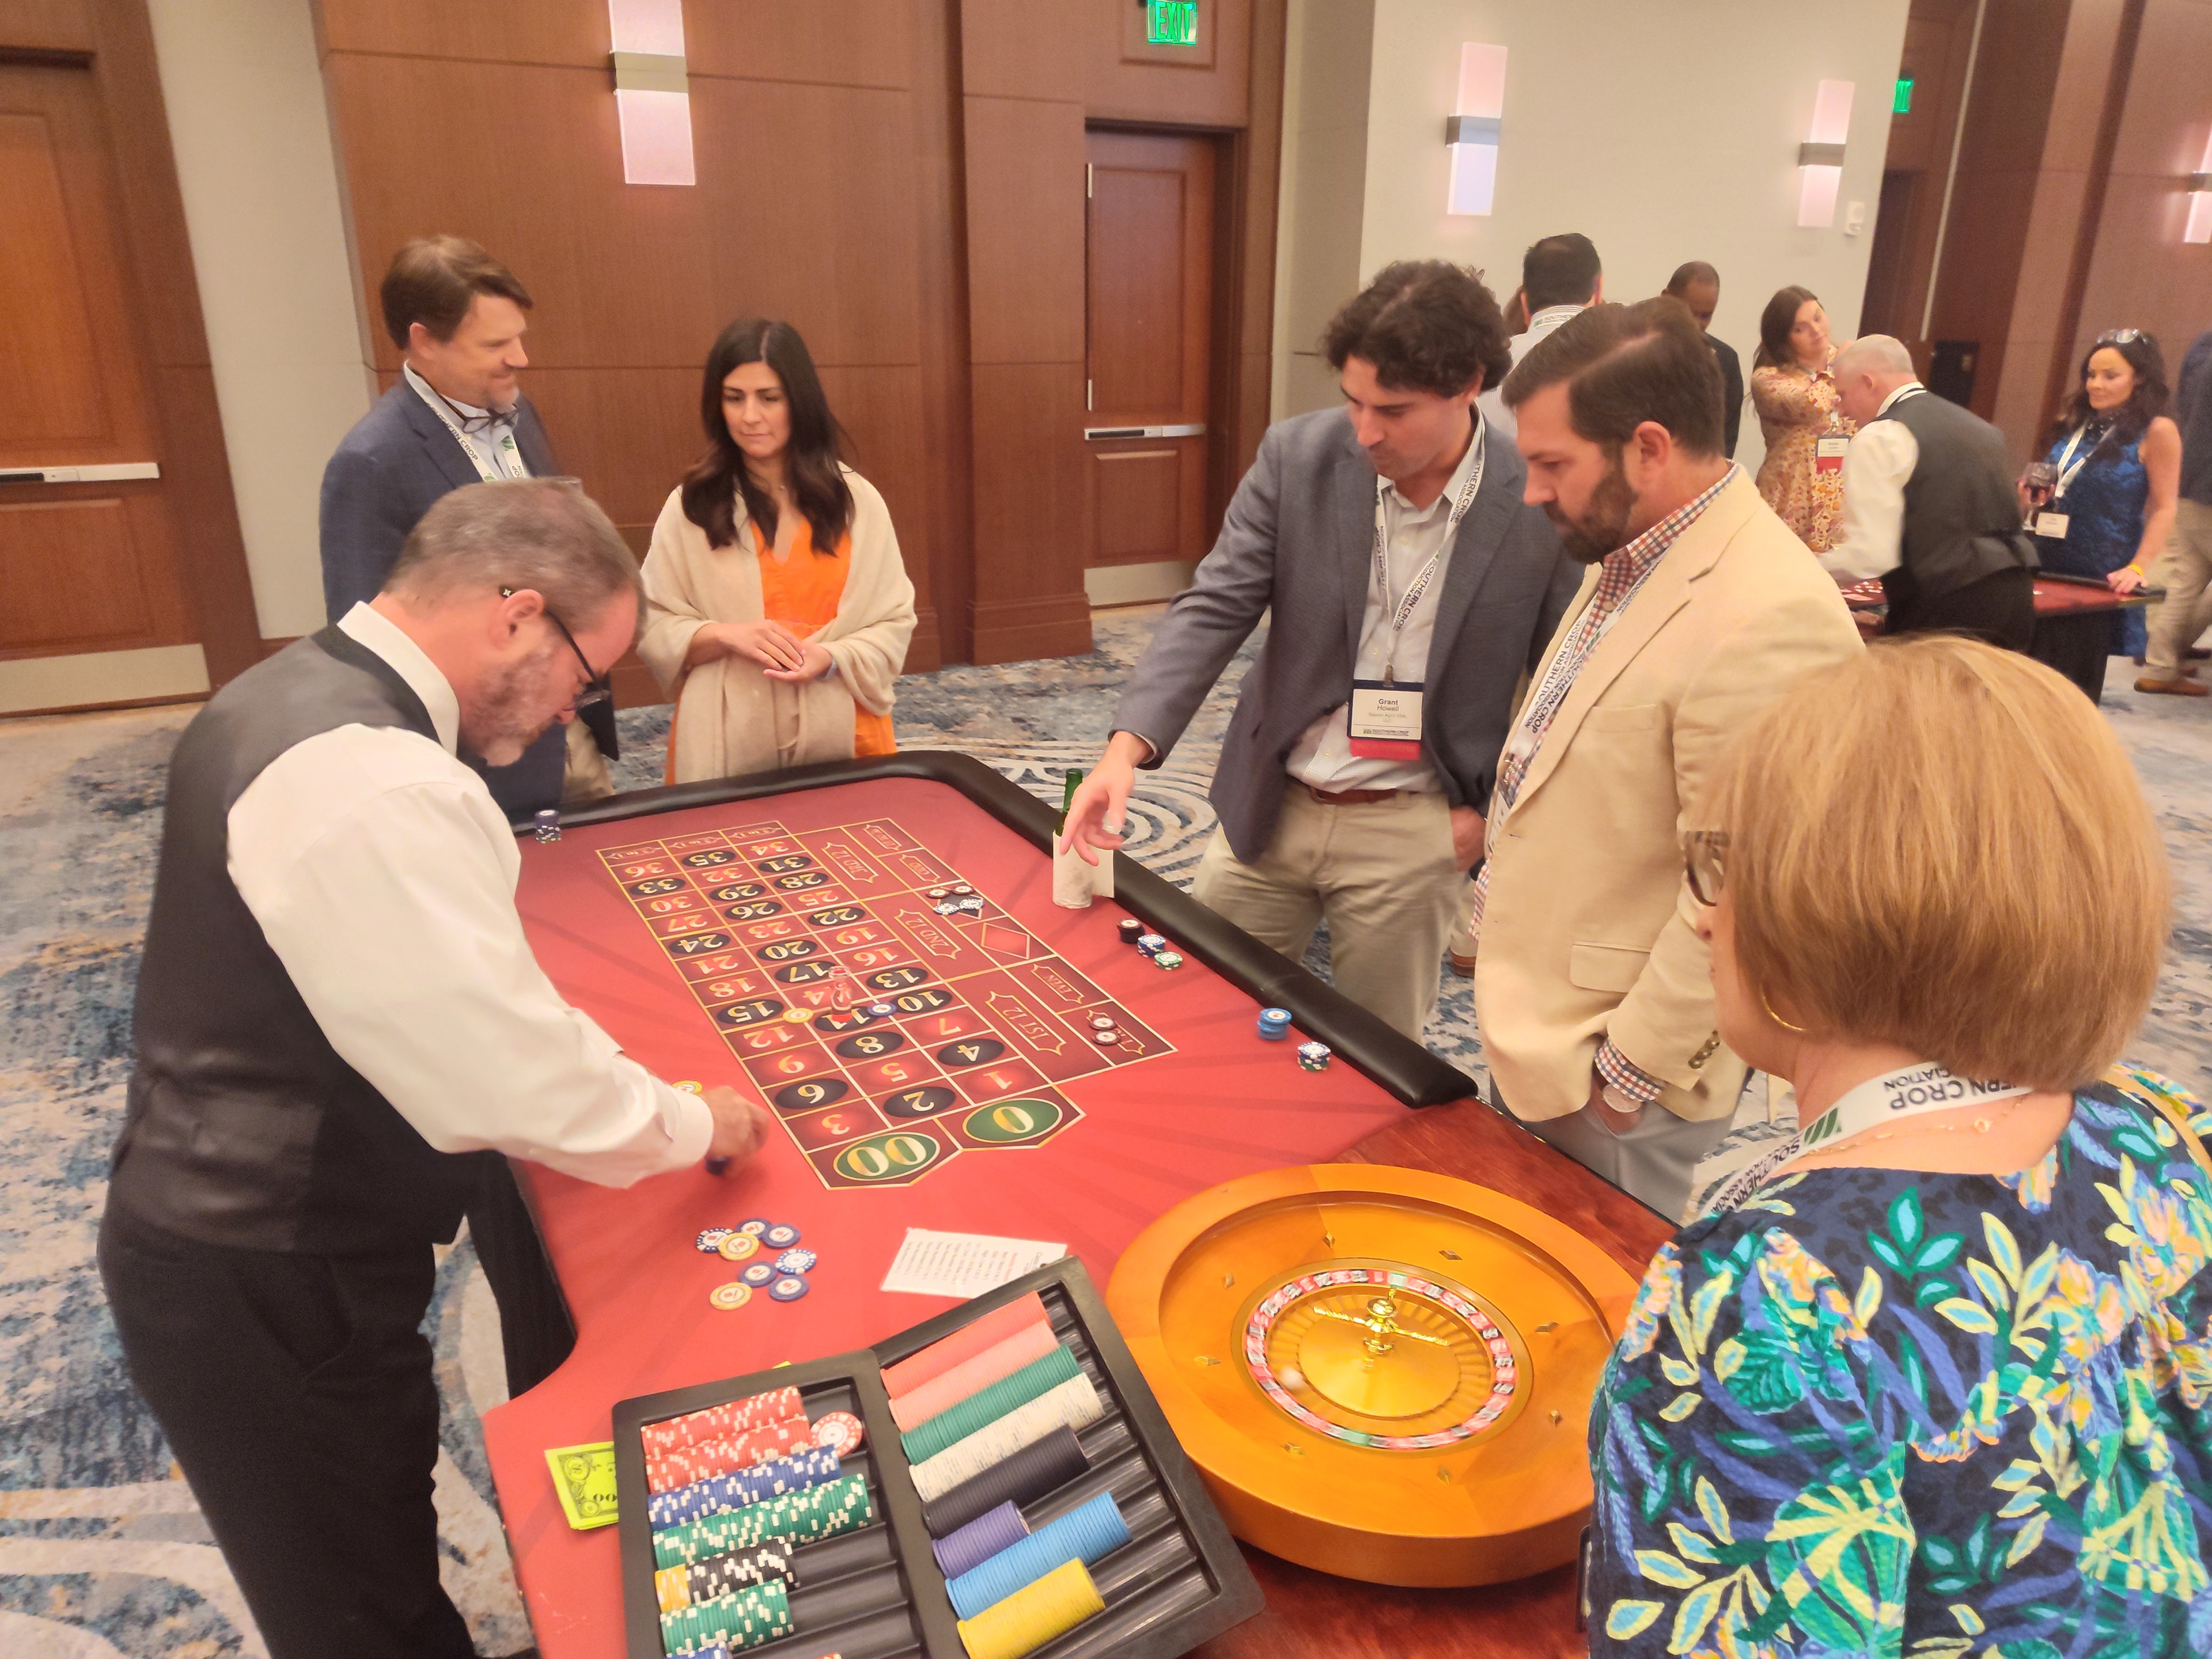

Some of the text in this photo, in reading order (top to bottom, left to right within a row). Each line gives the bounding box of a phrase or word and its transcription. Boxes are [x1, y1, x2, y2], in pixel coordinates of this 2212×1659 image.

[1155, 1, 1193, 40] EXIT
[460, 438, 478, 460] CROP
[512, 465, 520, 476] OP
[1454, 497, 1469, 523] CROP
[1407, 563, 1434, 607] OUTHERN
[1524, 690, 1554, 729] ASSOCIATION
[1529, 706, 1550, 733] CROP
[750, 841, 789, 855] 34
[689, 851, 728, 866] 35
[765, 857, 804, 871] 31
[624, 862, 665, 877] 36
[702, 868, 743, 882] 32
[638, 878, 676, 893] 33
[781, 873, 822, 889] 28
[718, 885, 759, 900] 29
[798, 890, 839, 907] 25
[651, 896, 692, 912] 30
[732, 902, 775, 918] 26
[667, 915, 708, 932] 27
[814, 908, 858, 925] 22
[749, 921, 791, 938] 23
[836, 927, 878, 945] 19
[906, 918, 949, 950] 2ND 12
[678, 934, 723, 953] 24
[766, 941, 810, 959] 20
[691, 955, 738, 974] 21
[853, 948, 898, 965] 16
[789, 961, 830, 982] 17
[875, 969, 921, 988] 13
[709, 977, 756, 998] 18
[1044, 975, 1070, 994] EVEN
[897, 991, 945, 1012] 10
[728, 1001, 775, 1022] 15
[938, 1018, 961, 1036] 7
[1002, 1006, 1050, 1040] 1ST 12
[743, 1025, 794, 1048] 12
[855, 1036, 884, 1054] 8
[957, 1044, 980, 1062] 4
[778, 1055, 805, 1074] 9
[881, 1062, 908, 1082] 5
[983, 1070, 1013, 1090] 1
[1884, 1069, 1952, 1092] CIATION
[797, 1084, 825, 1104] 6
[903, 1092, 934, 1111] 2
[1891, 1080, 1964, 1110] CROP
[821, 1114, 850, 1135] 3
[993, 1106, 1034, 1134] 0
[847, 1137, 927, 1176] 00
